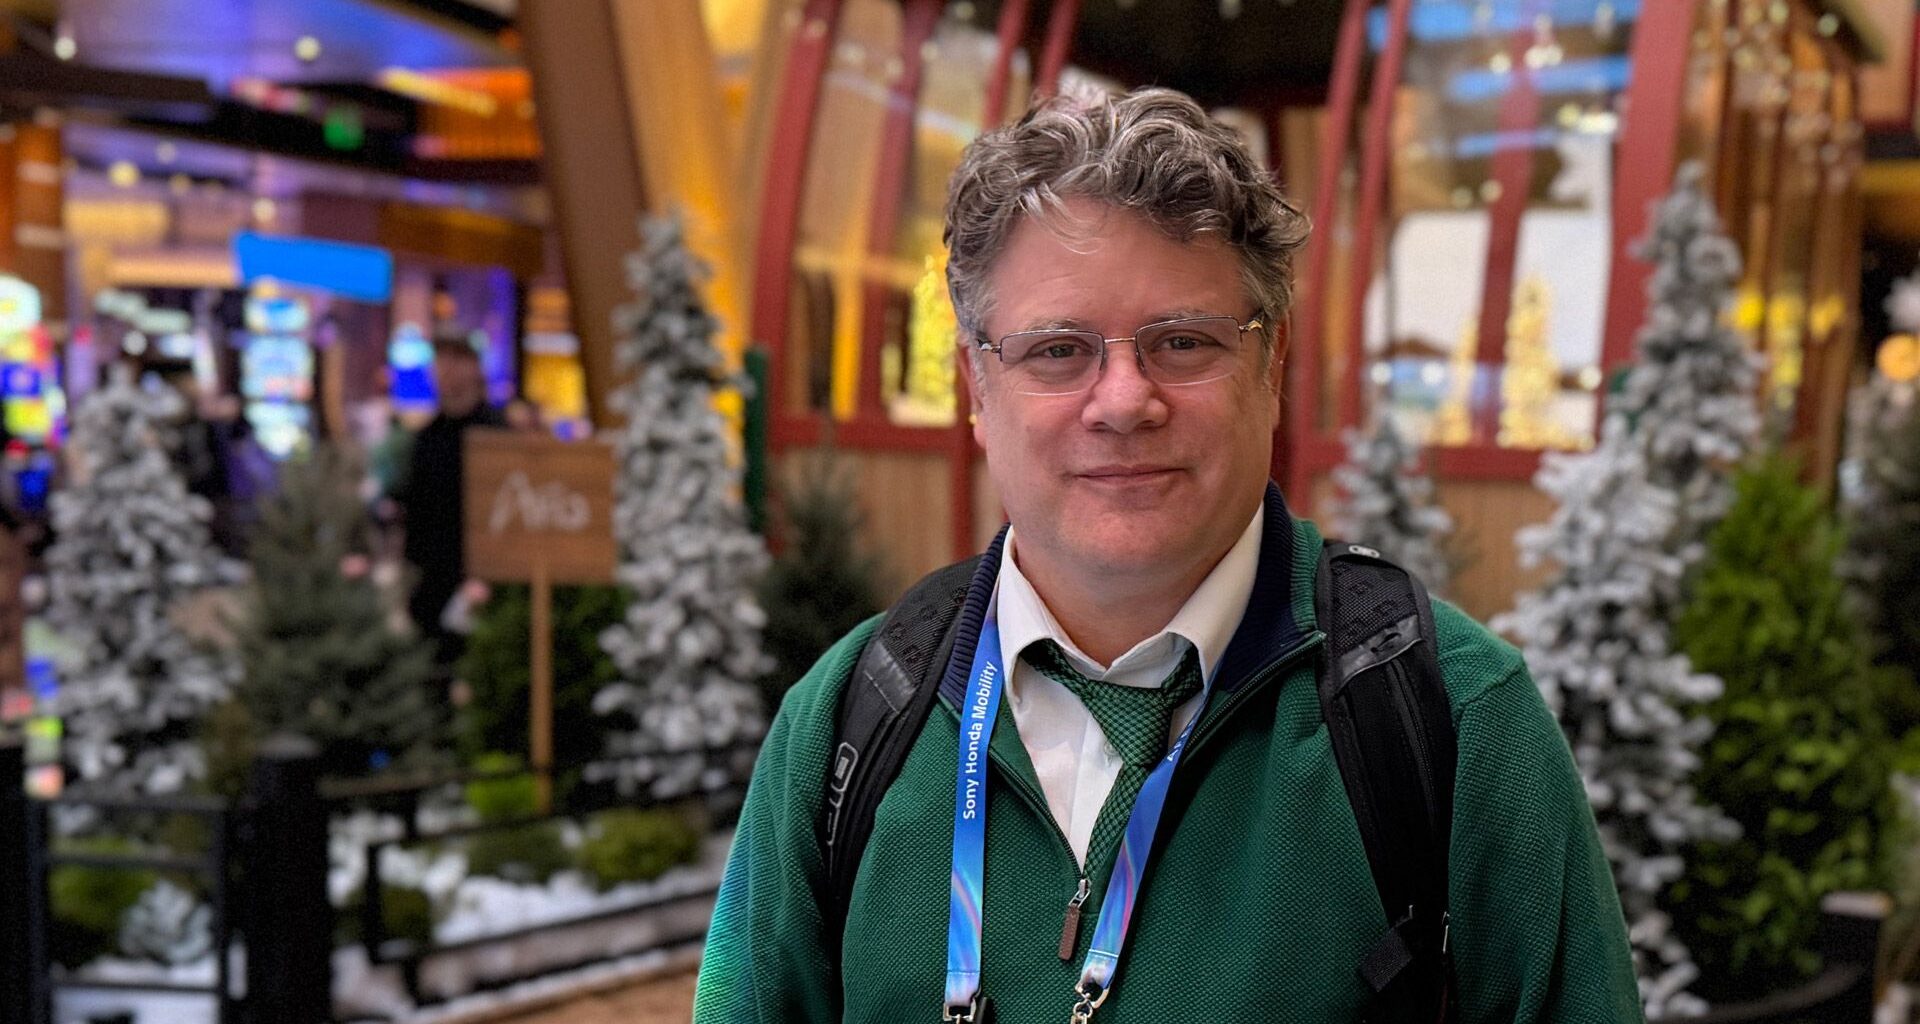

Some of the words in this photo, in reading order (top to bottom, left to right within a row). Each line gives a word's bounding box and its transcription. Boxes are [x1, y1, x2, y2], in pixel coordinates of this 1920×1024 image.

[971, 661, 998, 719] Mobility
[965, 722, 983, 774] Honda
[963, 778, 980, 819] Sony
